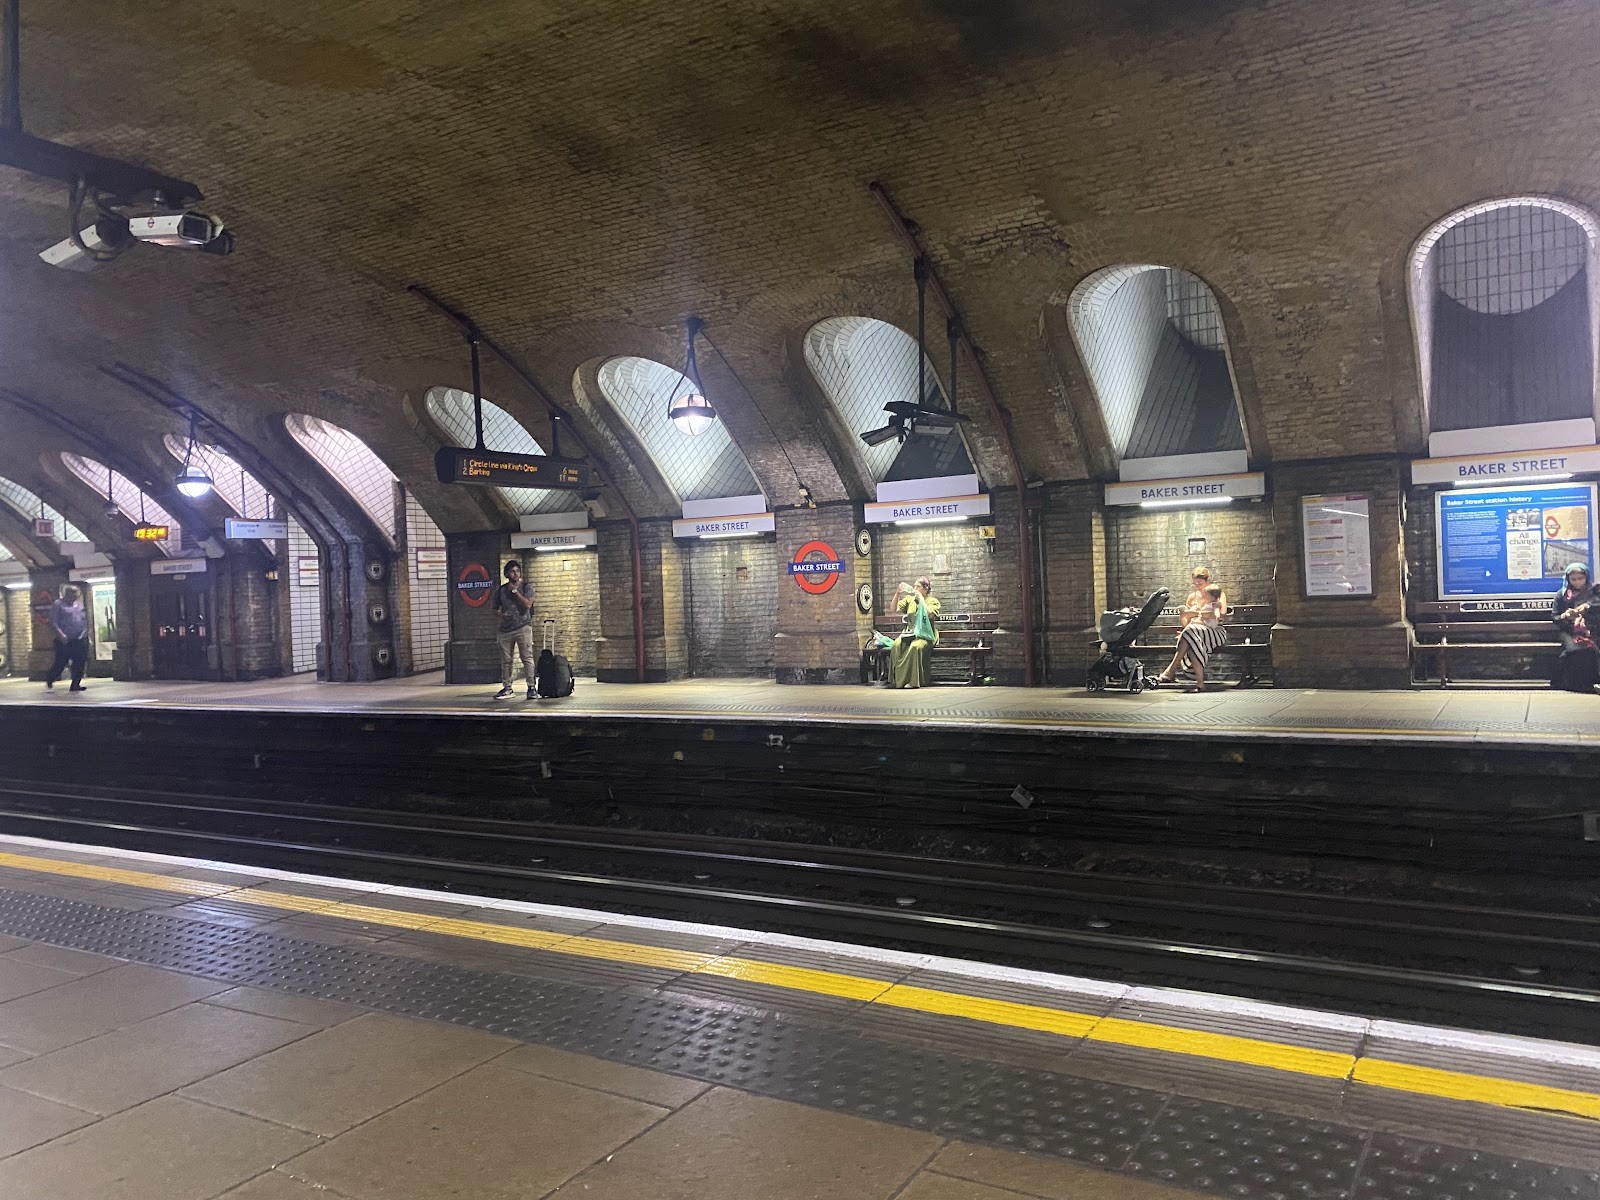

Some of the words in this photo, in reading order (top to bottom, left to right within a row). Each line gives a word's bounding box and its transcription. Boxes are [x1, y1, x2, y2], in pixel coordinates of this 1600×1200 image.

[469, 459, 488, 468] Circle
[1459, 463, 1506, 476] BAKER
[1512, 458, 1567, 472] STREET
[462, 467, 468, 475] 2
[469, 467, 490, 476] Barking
[1141, 487, 1178, 499] BAKER
[1182, 483, 1225, 495] STREET
[893, 507, 923, 518] BAKER
[925, 504, 959, 516] STREET
[696, 523, 720, 533] BAKER
[722, 521, 749, 531] STREET
[530, 537, 550, 545] BAKER
[552, 535, 576, 543] STREET
[793, 564, 814, 572] BAKER
[815, 562, 840, 571] STREET
[1477, 602, 1505, 610] BAKER
[1521, 601, 1553, 609] STREET
